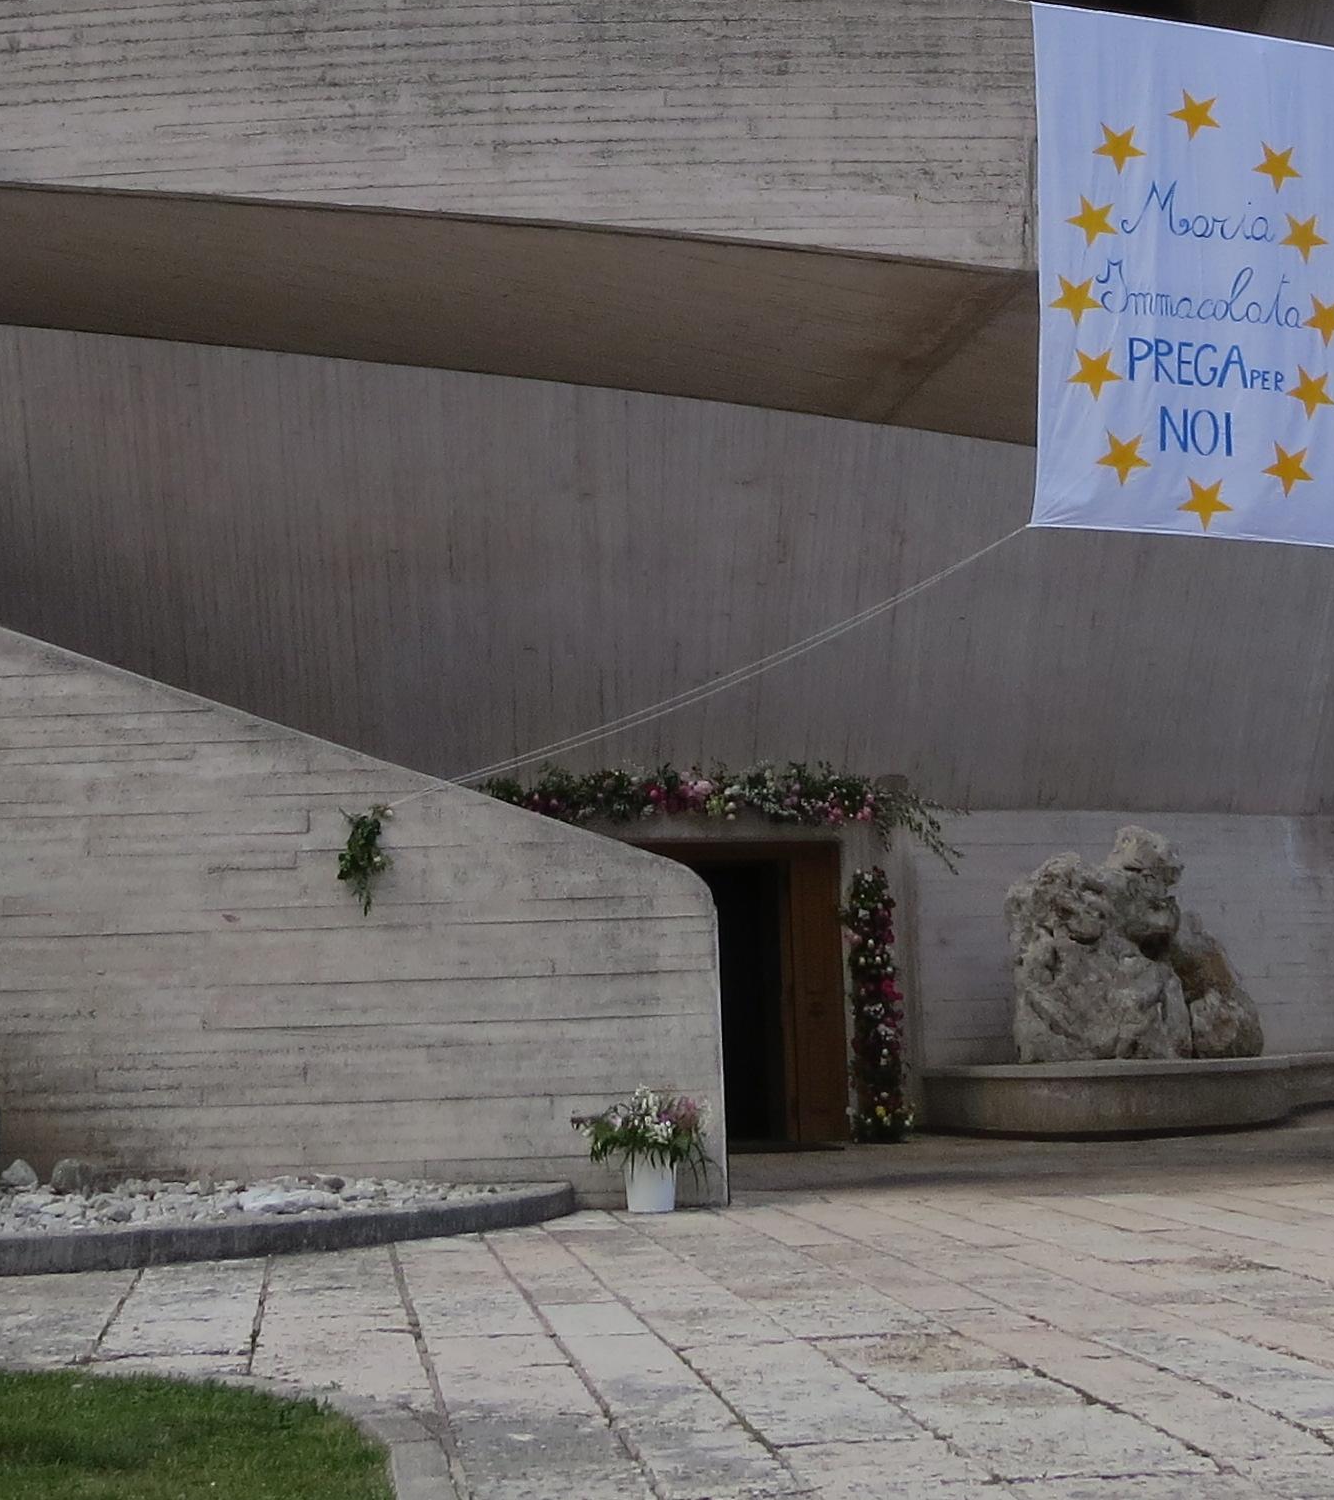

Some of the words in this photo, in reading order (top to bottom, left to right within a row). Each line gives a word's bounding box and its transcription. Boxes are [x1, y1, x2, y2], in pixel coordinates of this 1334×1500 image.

[1121, 180, 1275, 242] Maria
[1096, 259, 1304, 329] Immacolata
[1128, 338, 1249, 389] PREGA
[1250, 370, 1284, 392] PER
[1160, 406, 1233, 457] NOI
